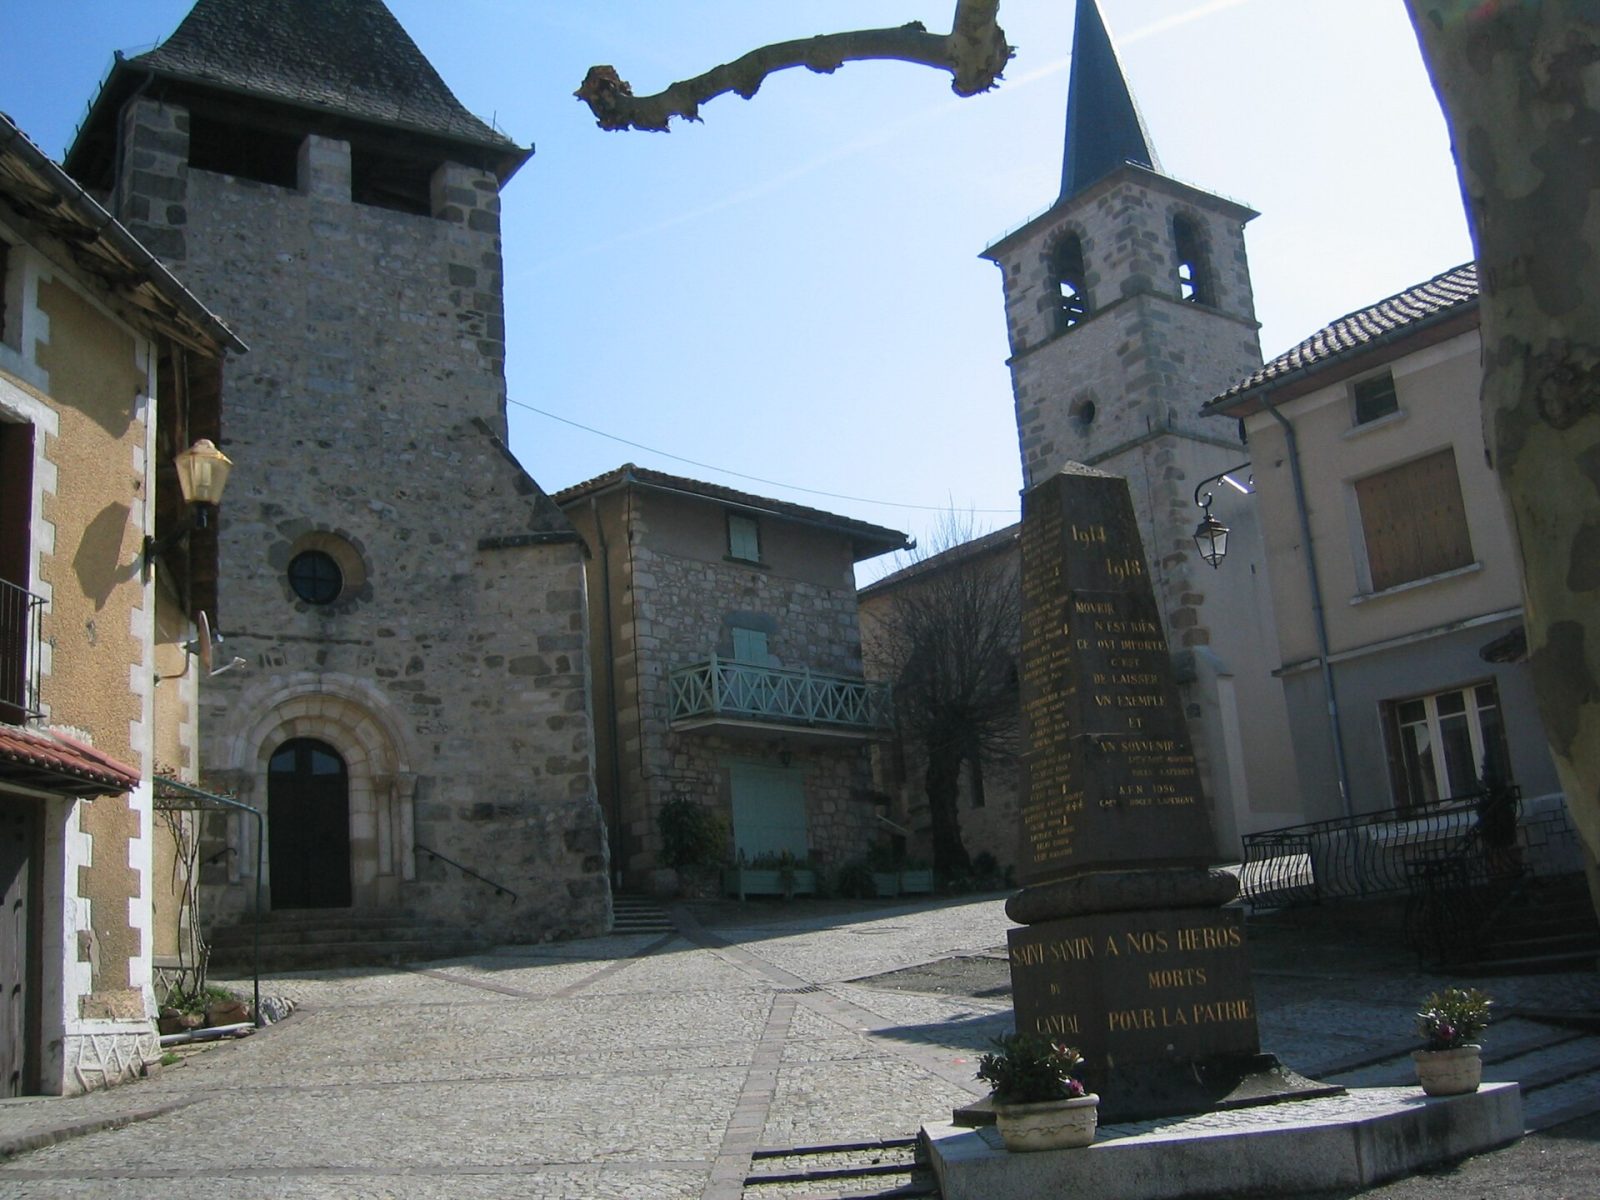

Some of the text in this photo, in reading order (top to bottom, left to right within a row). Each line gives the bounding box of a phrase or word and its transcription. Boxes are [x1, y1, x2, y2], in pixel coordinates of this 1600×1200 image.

[1072, 524, 1106, 550] 1914
[1105, 558, 1142, 583] 1918
[1076, 639, 1090, 650] CE
[1093, 673, 1159, 685] DE LAISSER
[1116, 695, 1168, 706] EXEMPLE
[1128, 717, 1142, 728] ET
[1105, 926, 1242, 957] A NOS HEROS
[1149, 968, 1207, 989] MORTS
[1036, 1013, 1081, 1034] CANTAL
[1108, 1000, 1254, 1032] POVR LA PATRIE
